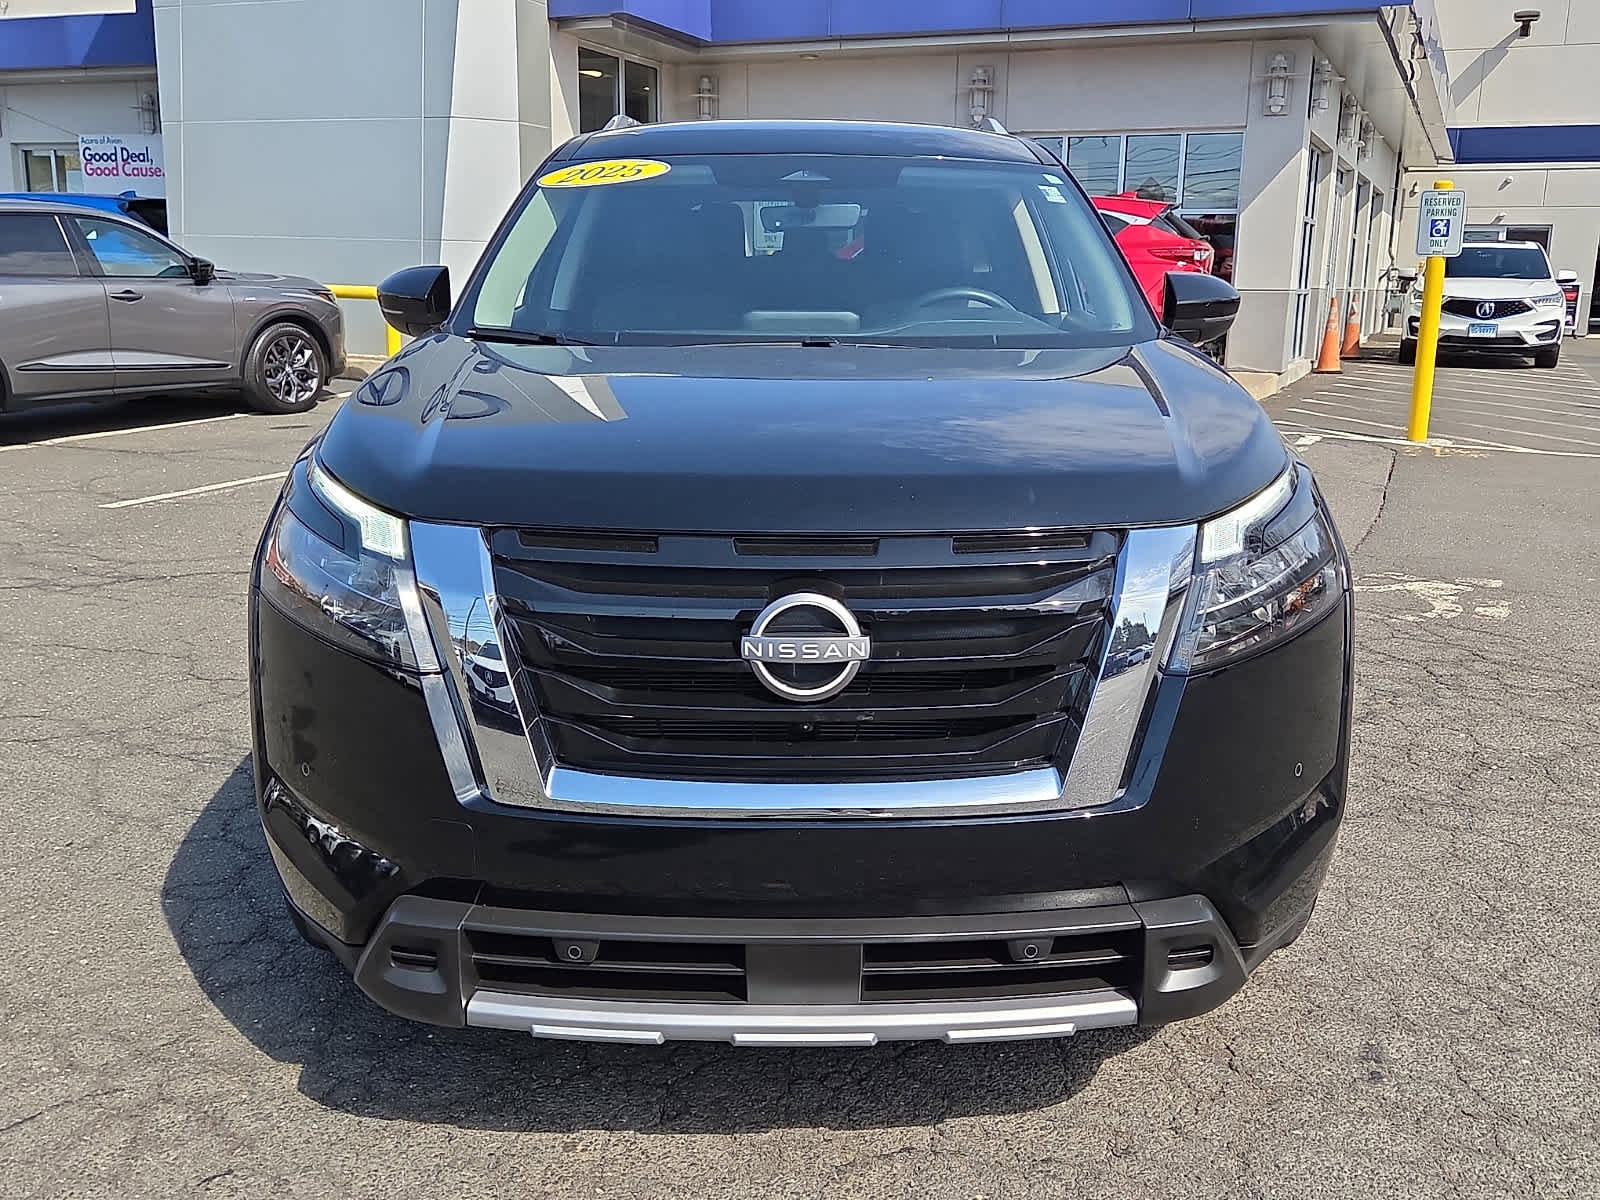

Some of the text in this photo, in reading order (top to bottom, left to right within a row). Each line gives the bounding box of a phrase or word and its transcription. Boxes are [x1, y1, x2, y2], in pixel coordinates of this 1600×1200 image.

[82, 146, 153, 165] Good Deal,
[84, 161, 165, 177] Good Cause.
[556, 164, 650, 184] 2025
[1424, 197, 1461, 206] RESERVED
[1426, 208, 1457, 216] PARKING
[1430, 239, 1448, 247] ONLY
[744, 641, 866, 659] NISSAN
